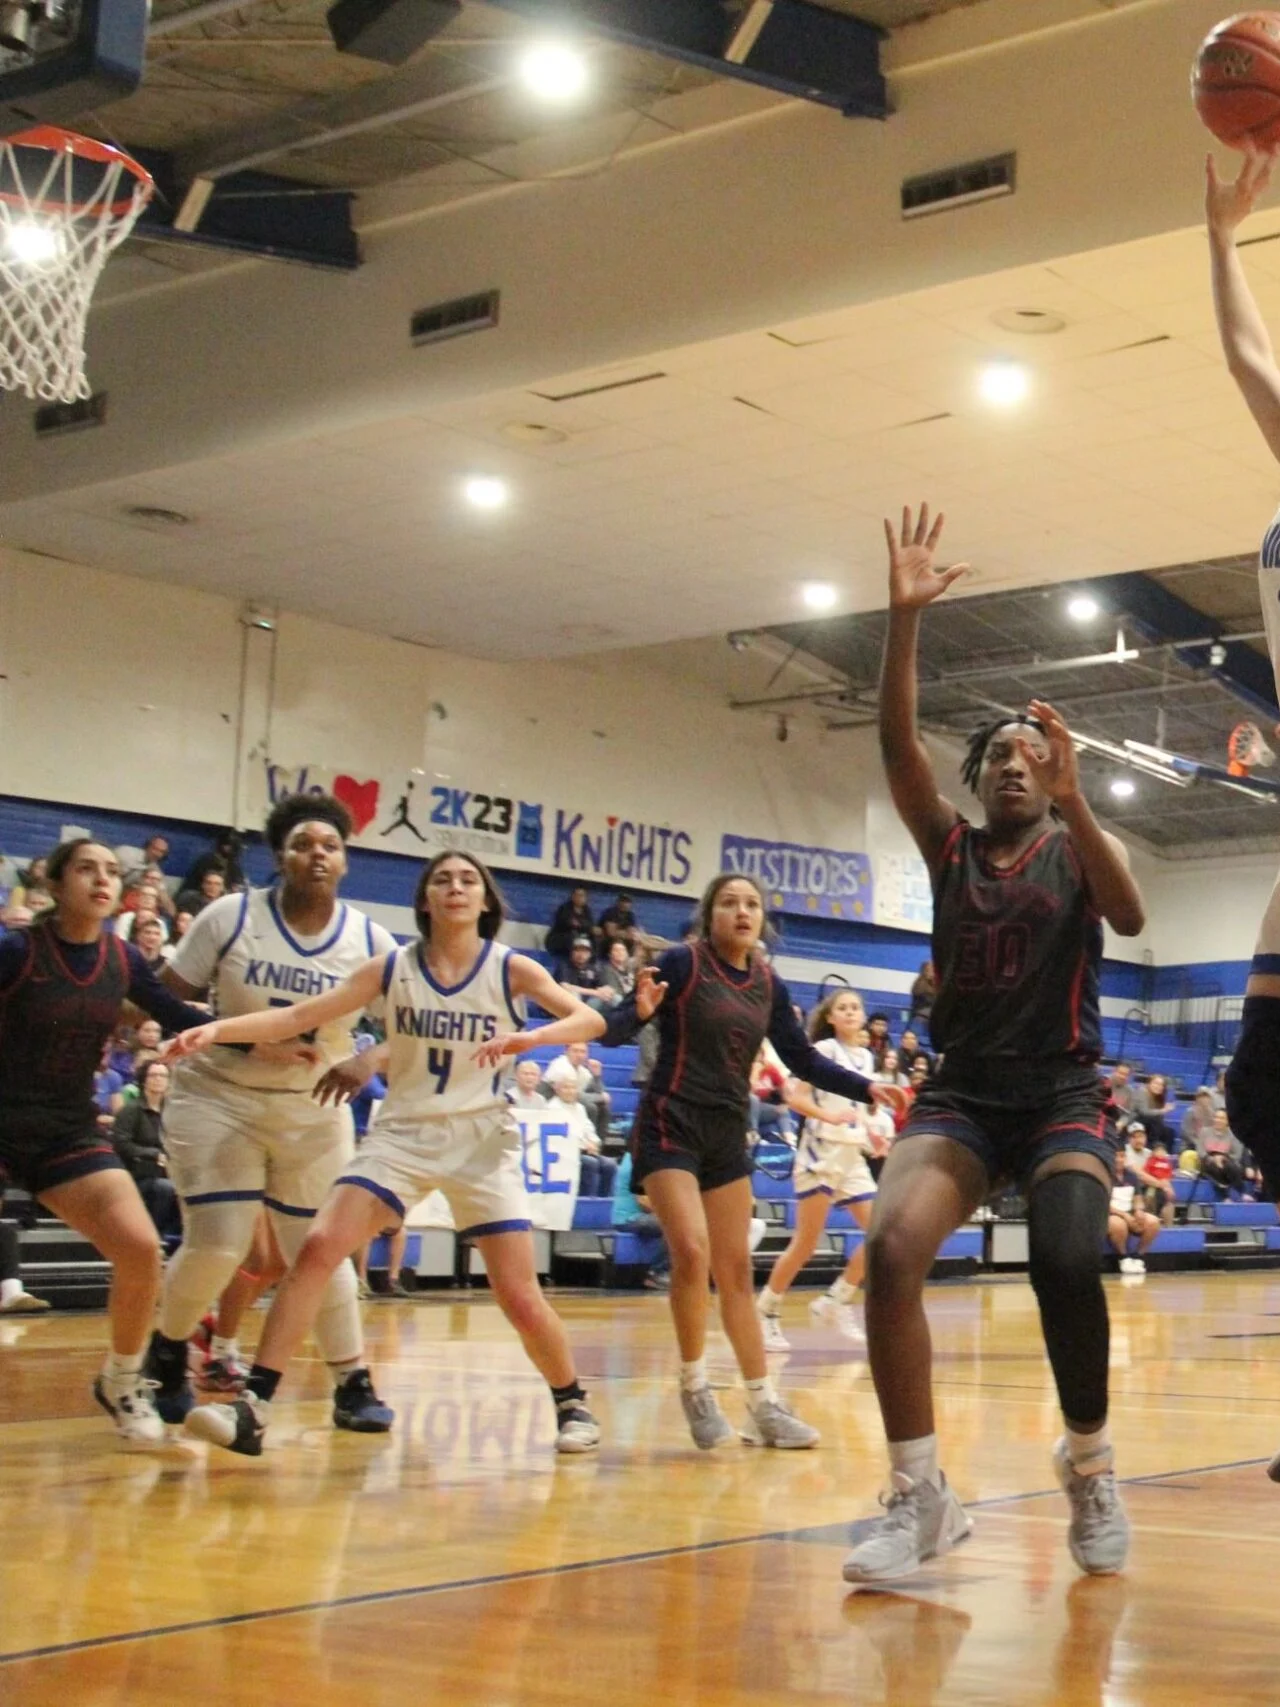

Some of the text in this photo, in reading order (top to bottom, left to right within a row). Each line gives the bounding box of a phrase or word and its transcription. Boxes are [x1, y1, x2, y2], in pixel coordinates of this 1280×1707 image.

[430, 785, 512, 835] 2K23
[725, 846, 859, 896] VISITORS
[244, 959, 340, 996] KNIGHT
[395, 1006, 498, 1042] KNIGHTS
[428, 1047, 453, 1094] 4
